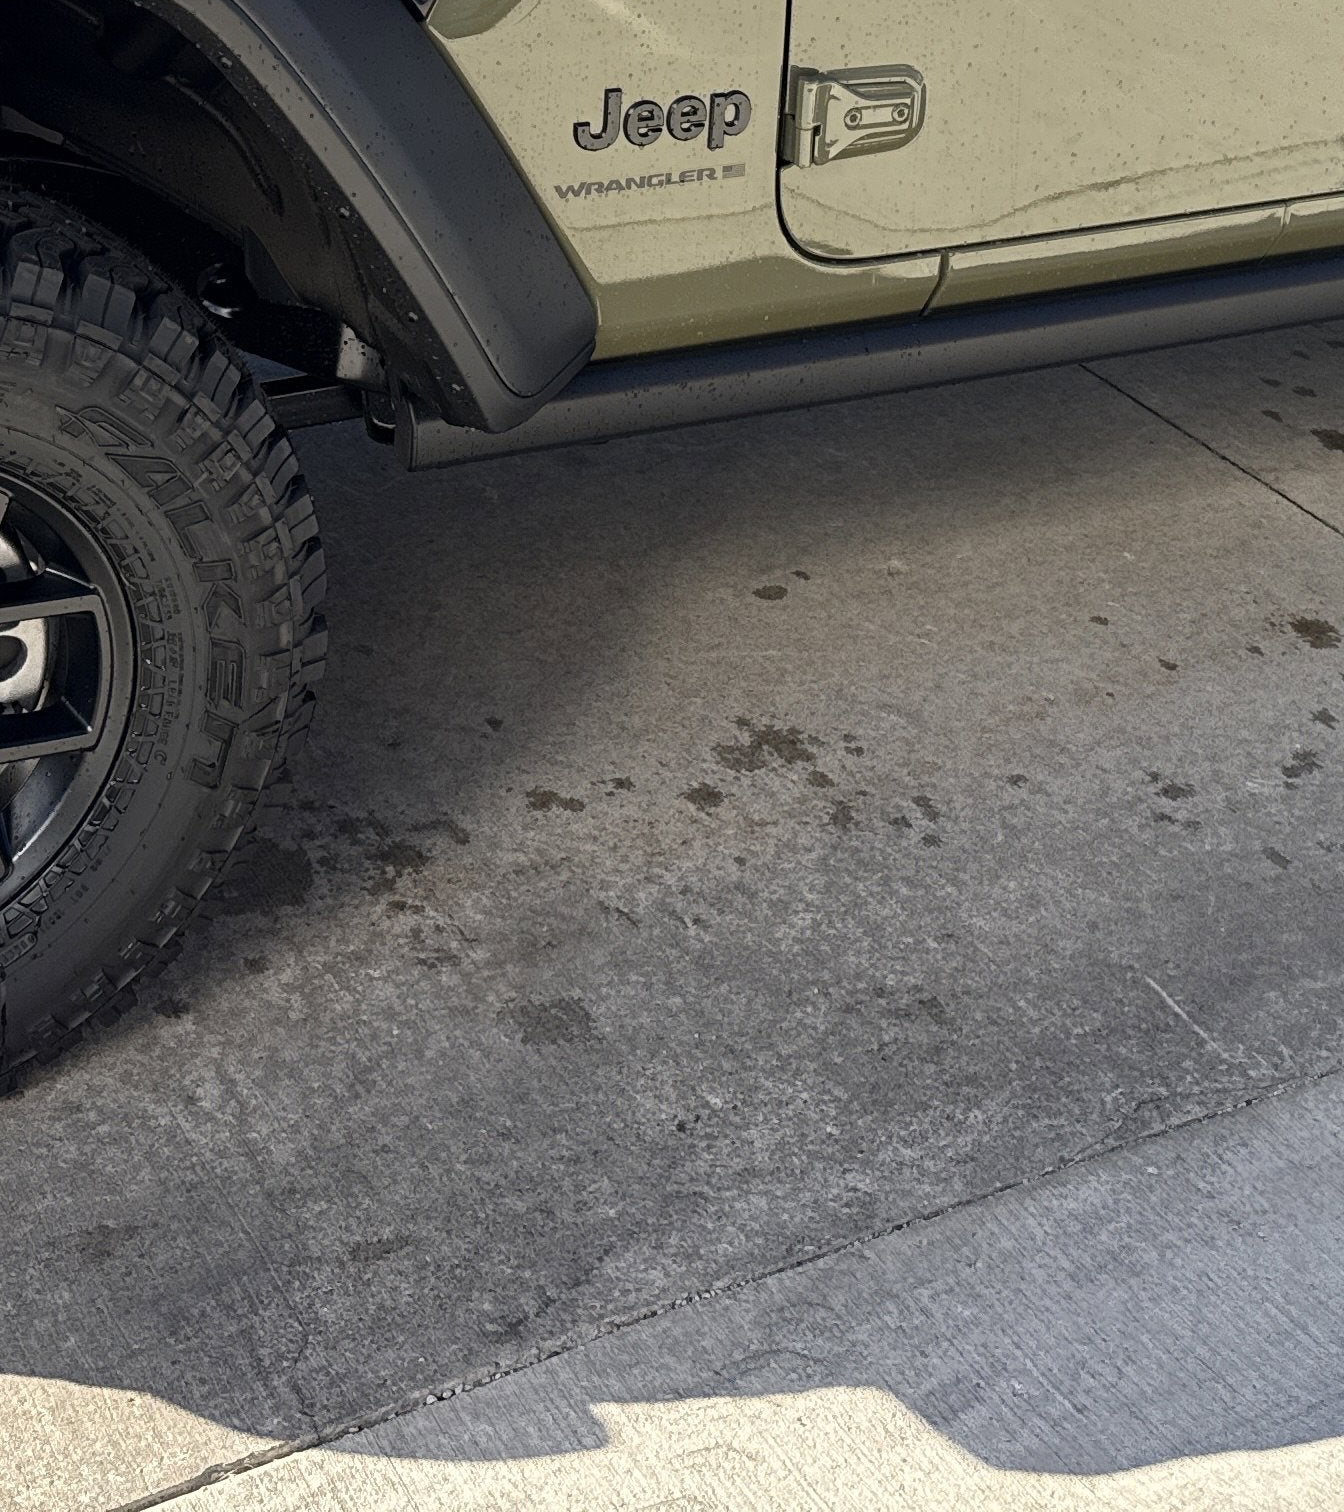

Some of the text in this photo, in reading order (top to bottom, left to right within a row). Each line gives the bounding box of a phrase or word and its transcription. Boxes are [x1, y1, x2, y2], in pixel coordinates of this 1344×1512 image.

[572, 87, 752, 151] Jeep
[553, 167, 718, 199] WRANGLER
[55, 403, 247, 789] FALKEN
